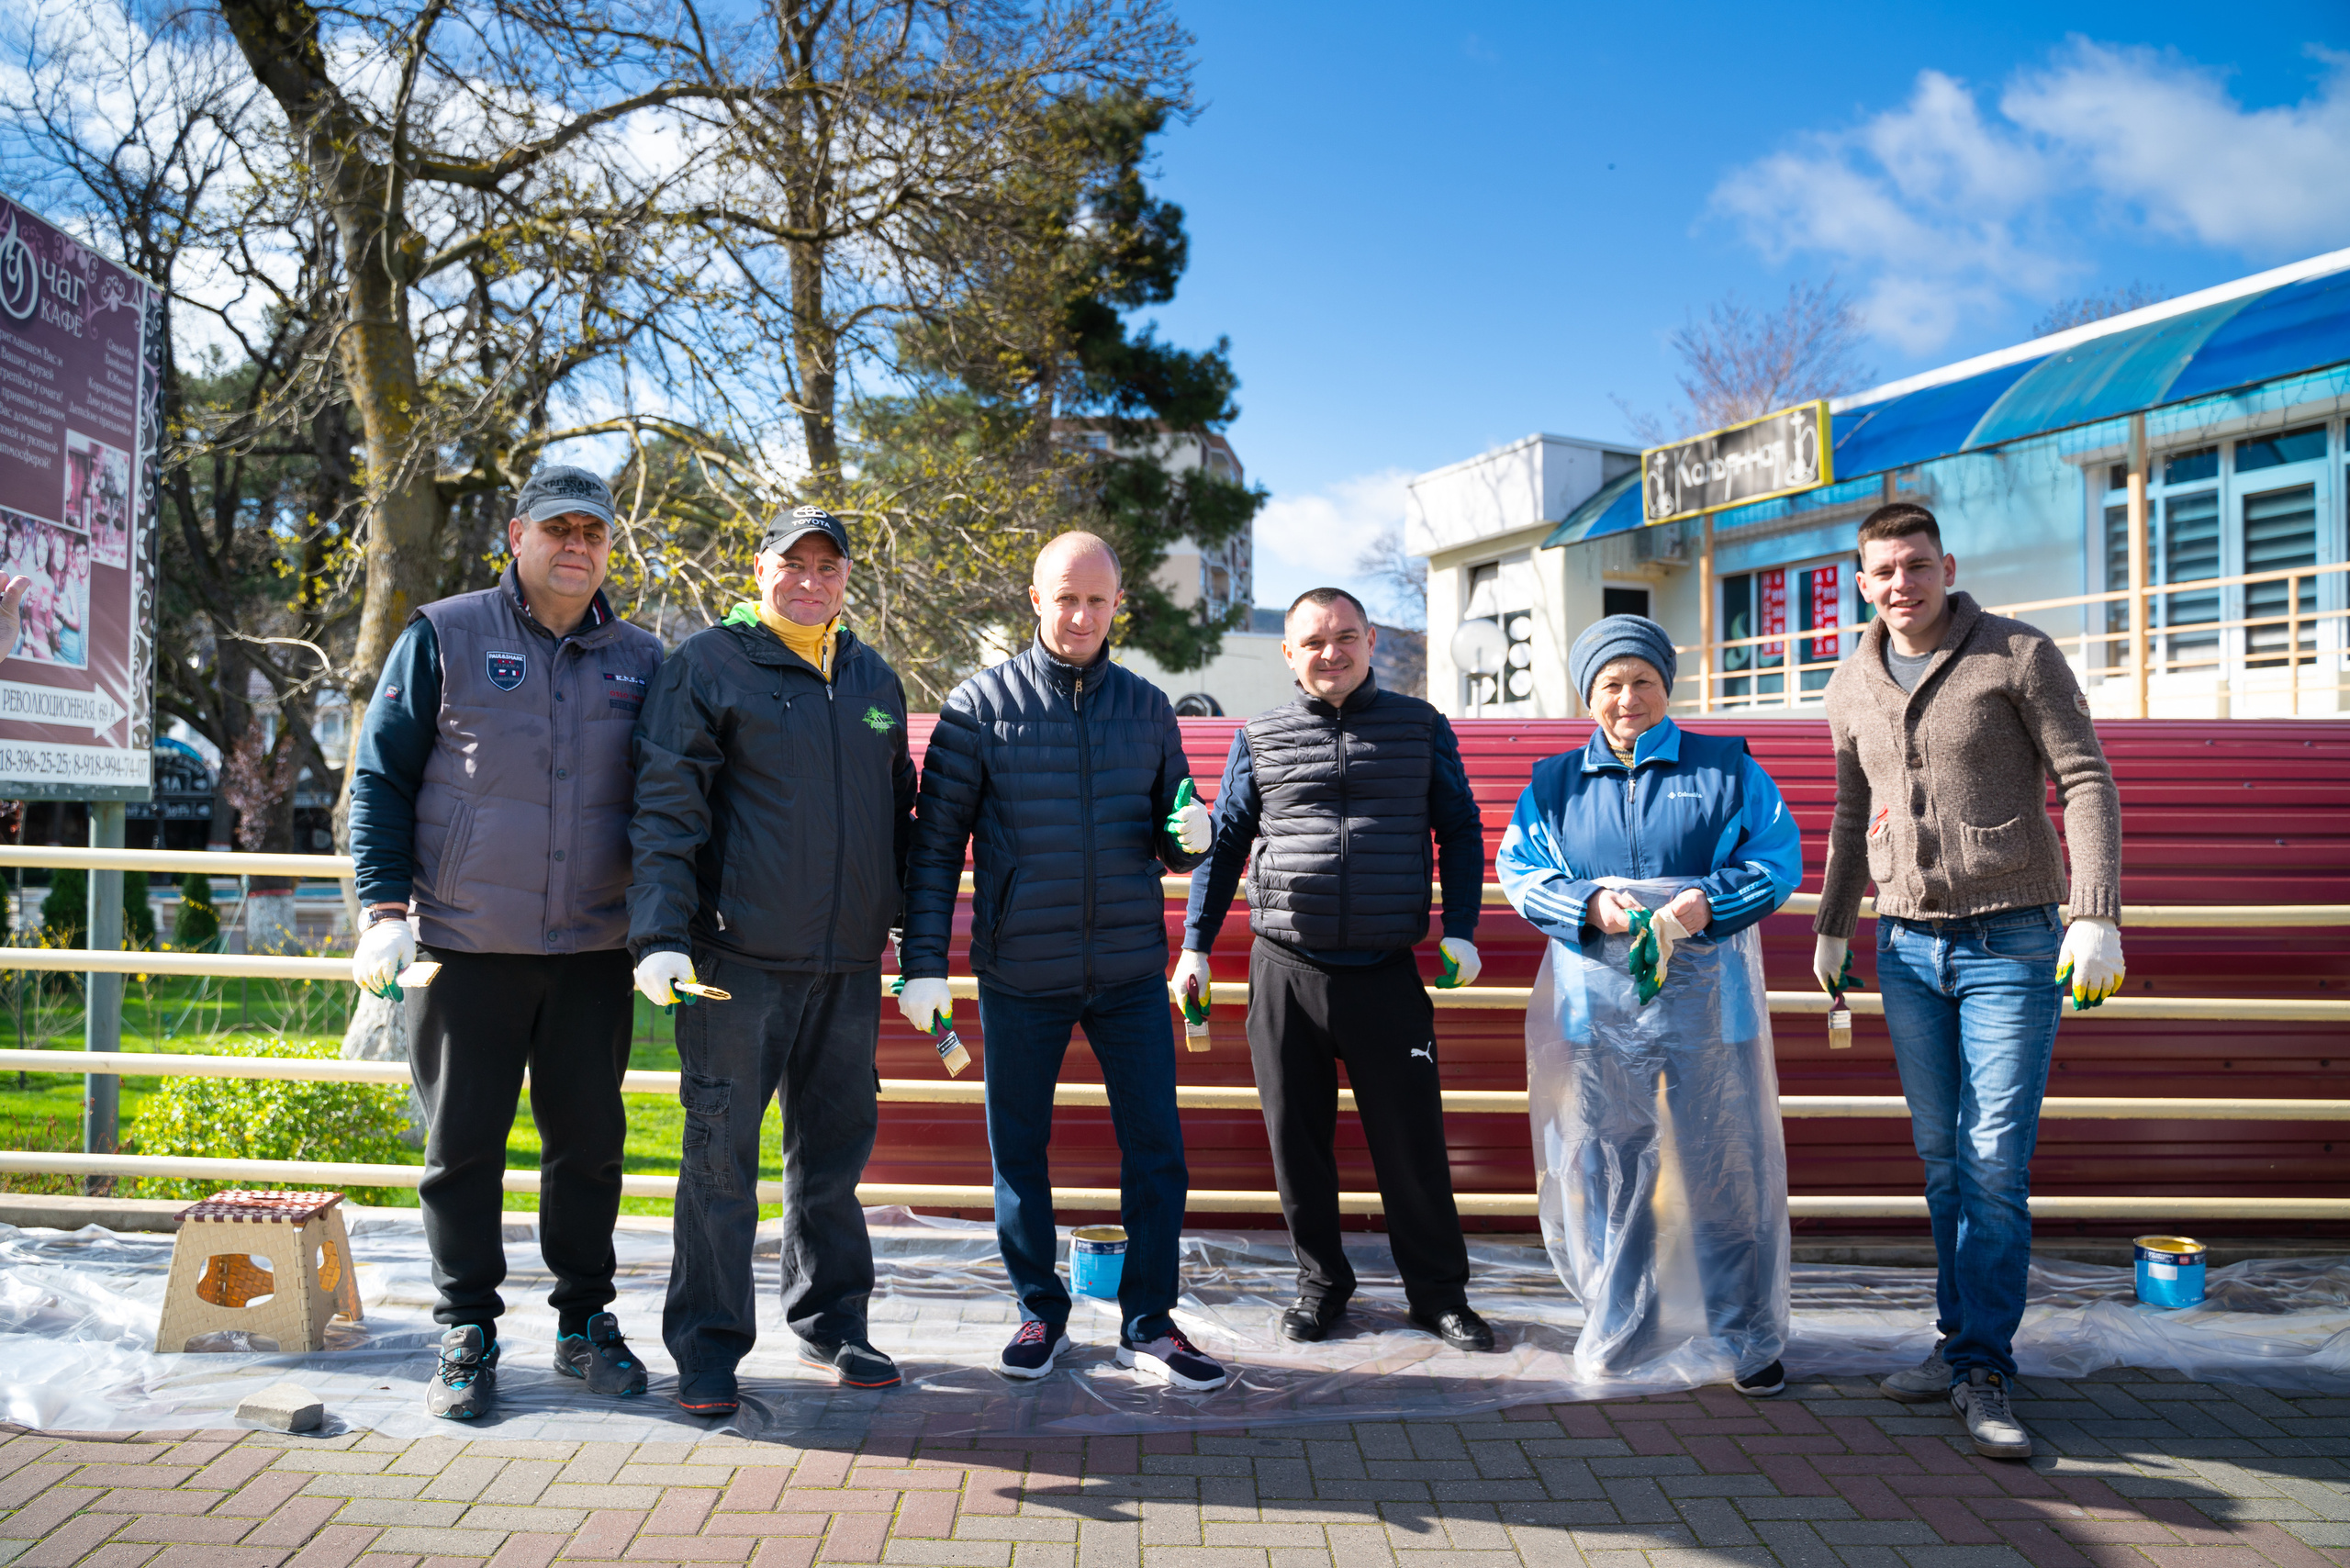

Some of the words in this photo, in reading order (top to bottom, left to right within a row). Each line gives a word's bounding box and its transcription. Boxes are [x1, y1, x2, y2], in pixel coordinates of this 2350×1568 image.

[40, 297, 83, 338] КАФЕ
[0, 329, 42, 358] риглашаем
[1, 344, 27, 369] Ваших
[28, 361, 54, 382] друзей
[2, 386, 37, 410] приятно
[38, 401, 66, 422] удивим
[40, 384, 63, 403] очага!
[13, 409, 53, 434] домашней
[0, 422, 19, 440] хней
[20, 432, 26, 442] и
[26, 432, 59, 455] уютной
[791, 518, 831, 530] TOYOTA
[2, 689, 96, 722] РЕВОЛЮЦИОННАЯ,
[98, 703, 108, 722] 69
[610, 690, 629, 699] OSLO
[0, 747, 72, 778] 18-396-25-25;
[73, 753, 148, 778] 8-918-994-74-07
